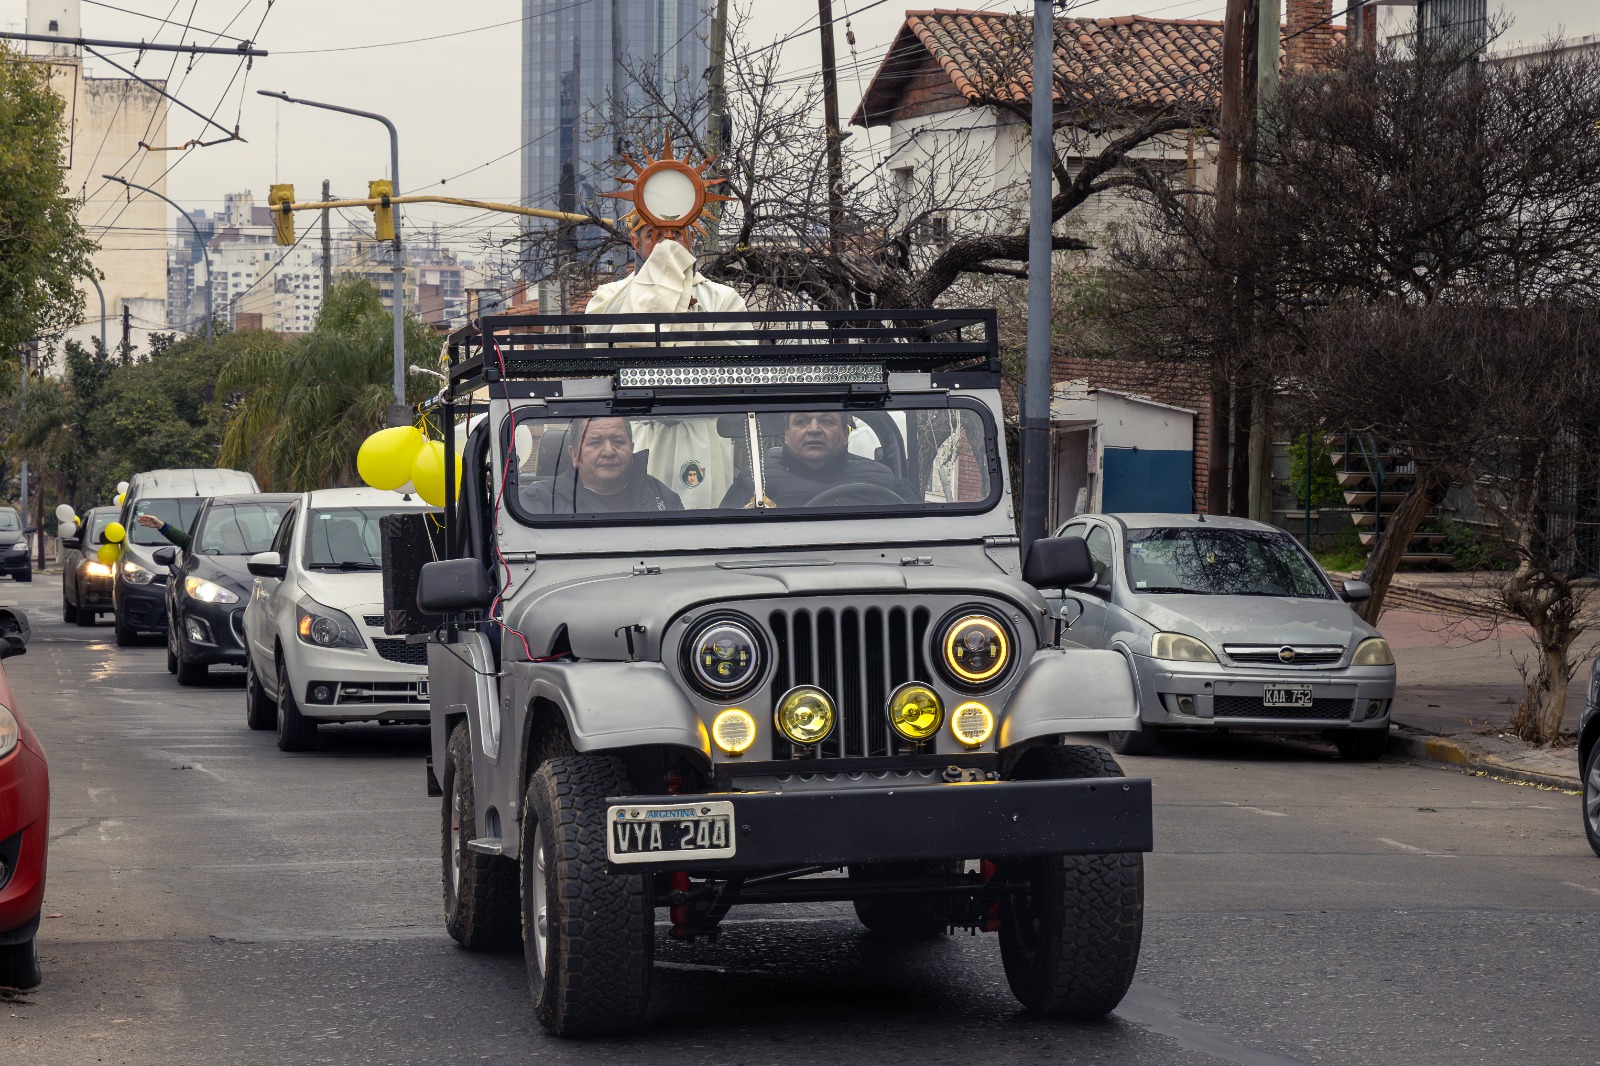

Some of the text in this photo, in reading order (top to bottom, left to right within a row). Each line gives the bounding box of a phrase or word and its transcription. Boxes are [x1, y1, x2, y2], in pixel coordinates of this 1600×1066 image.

[1266, 690, 1311, 703] KAA 752
[647, 809, 695, 819] ARGENTINA
[616, 819, 726, 851] VYA 244
